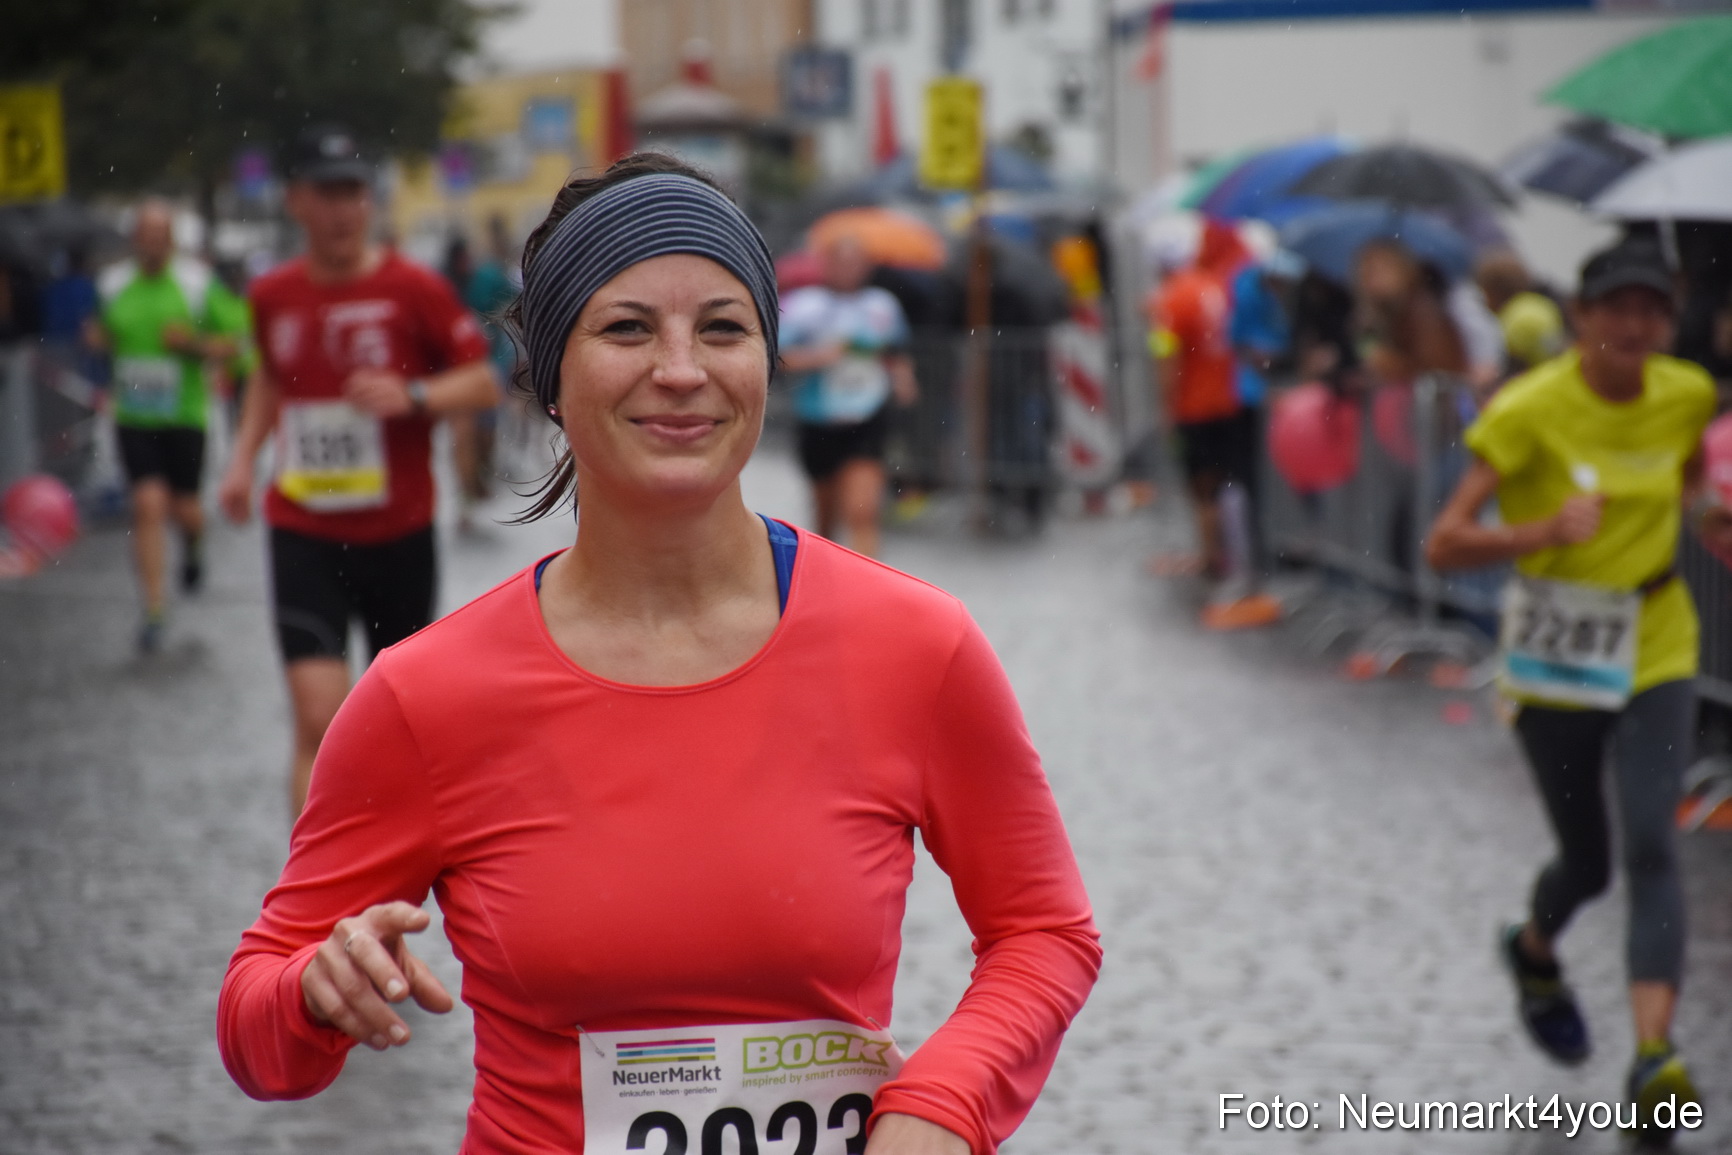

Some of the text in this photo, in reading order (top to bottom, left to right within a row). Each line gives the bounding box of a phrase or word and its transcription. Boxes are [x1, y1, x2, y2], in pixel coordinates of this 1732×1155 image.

[743, 1031, 893, 1074] BOCK
[612, 1065, 722, 1085] NeuerMarkt
[742, 1063, 889, 1088] inspired by smart concepts
[619, 1086, 717, 1098] einkaufen leben genießen
